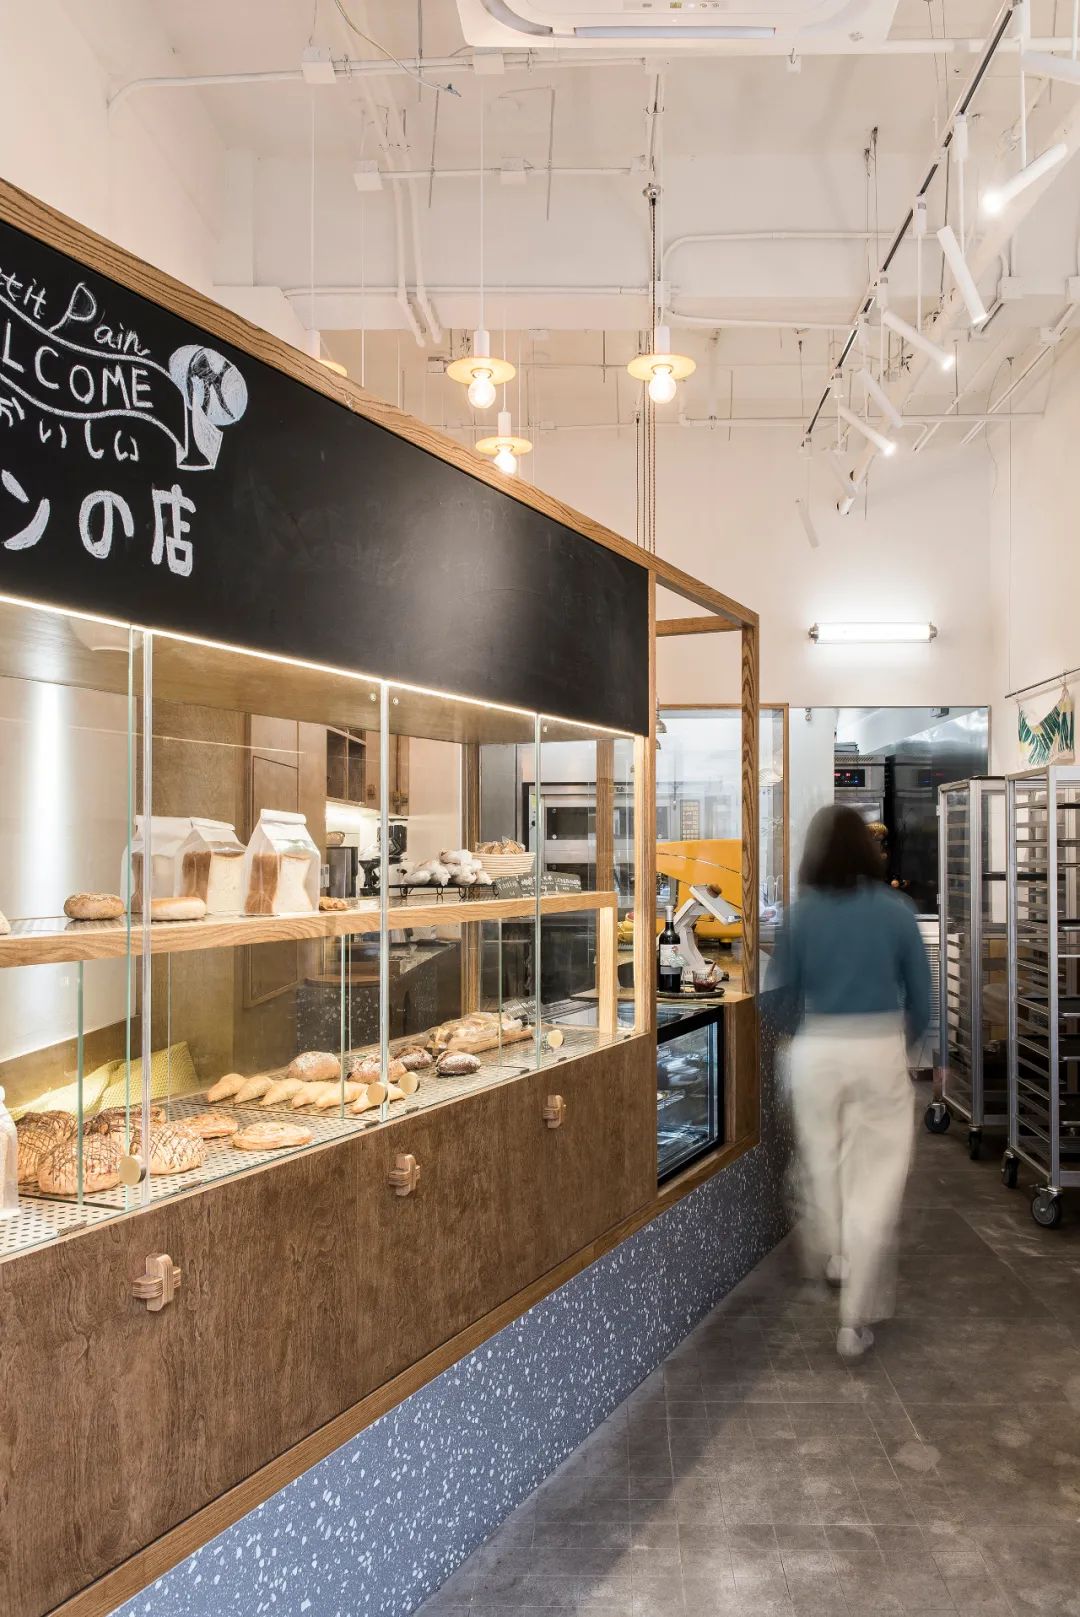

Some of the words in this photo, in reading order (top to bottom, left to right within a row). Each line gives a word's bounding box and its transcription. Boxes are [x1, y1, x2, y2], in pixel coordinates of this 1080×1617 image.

[0, 266, 47, 319] tit
[47, 282, 150, 355] Pain
[0, 319, 152, 408] LCOME
[1, 469, 196, 577] ンの店
